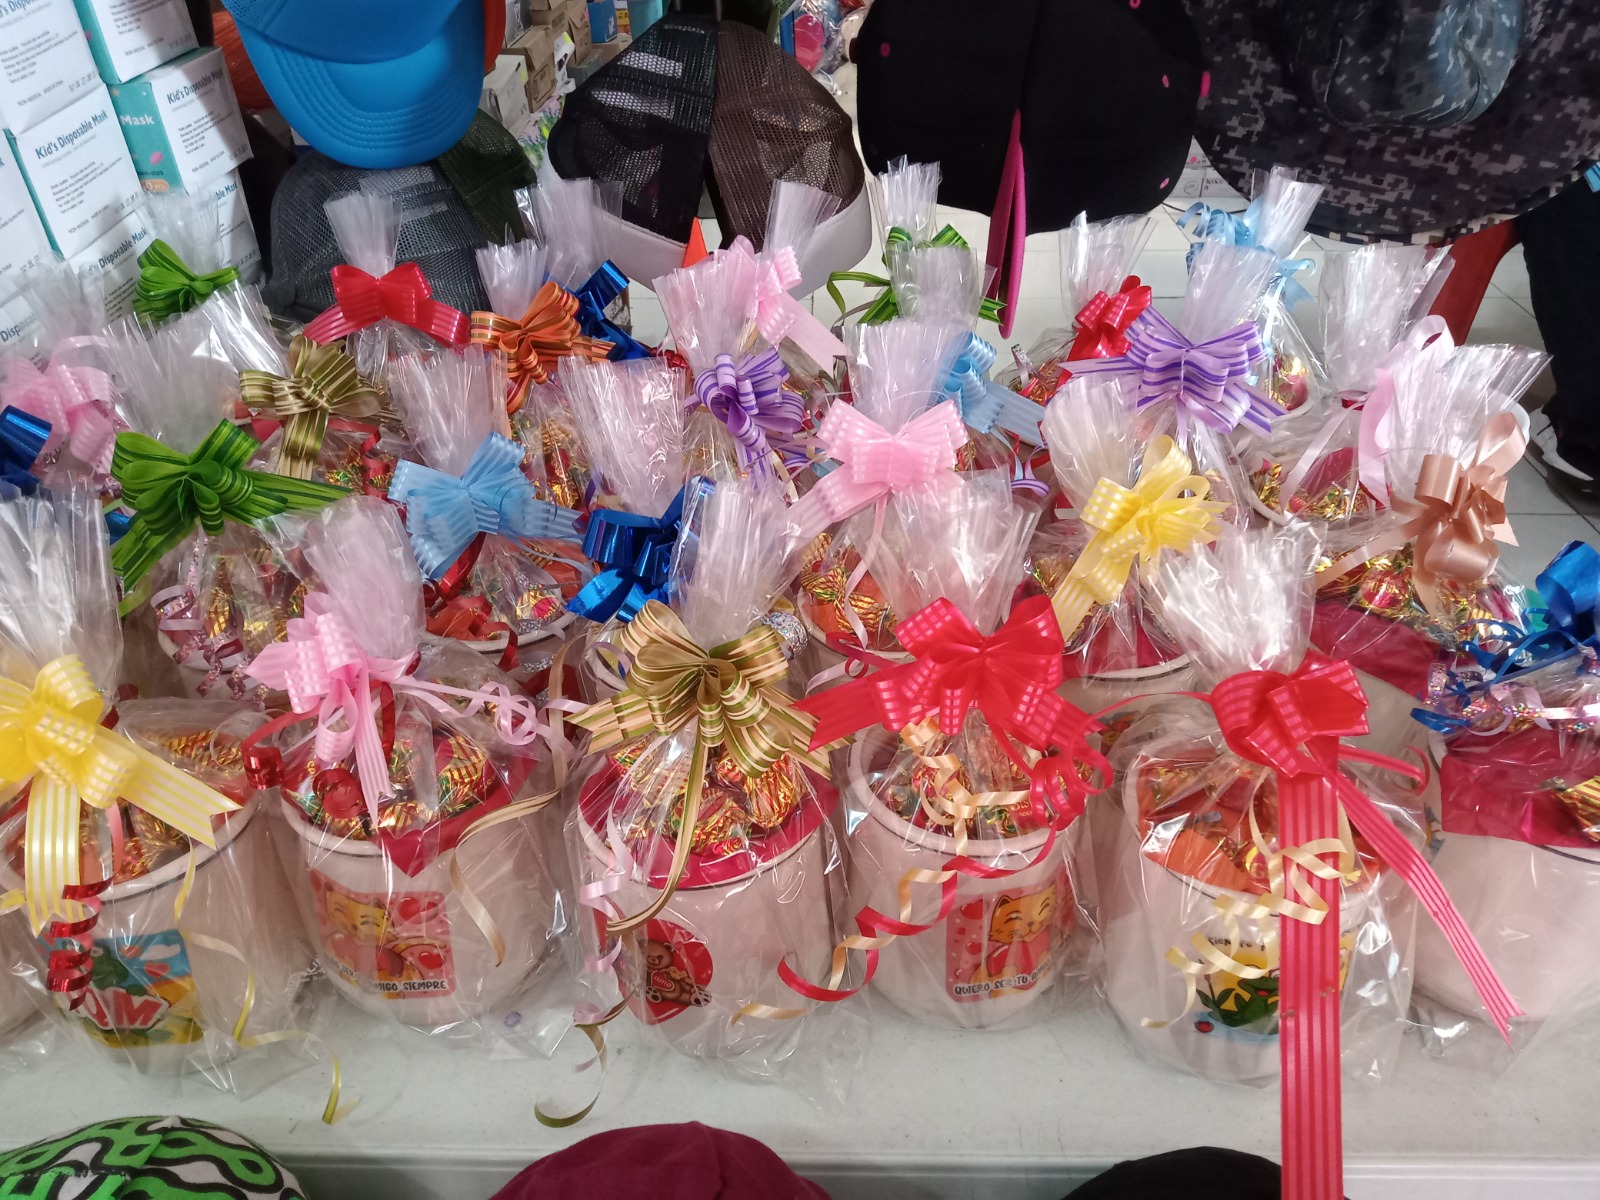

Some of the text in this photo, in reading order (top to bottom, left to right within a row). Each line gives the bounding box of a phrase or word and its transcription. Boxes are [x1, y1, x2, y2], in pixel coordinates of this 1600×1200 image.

[167, 89, 185, 104] Kid's
[183, 74, 212, 96] Disposable
[119, 114, 155, 126] Mask
[35, 141, 59, 160] Kid's
[57, 120, 93, 146] Disposable
[91, 109, 109, 127] Mask
[98, 240, 133, 269] Disposable
[131, 227, 148, 245] Mask
[402, 980, 447, 991] SIEMPRE
[954, 983, 990, 995] QUIERO
